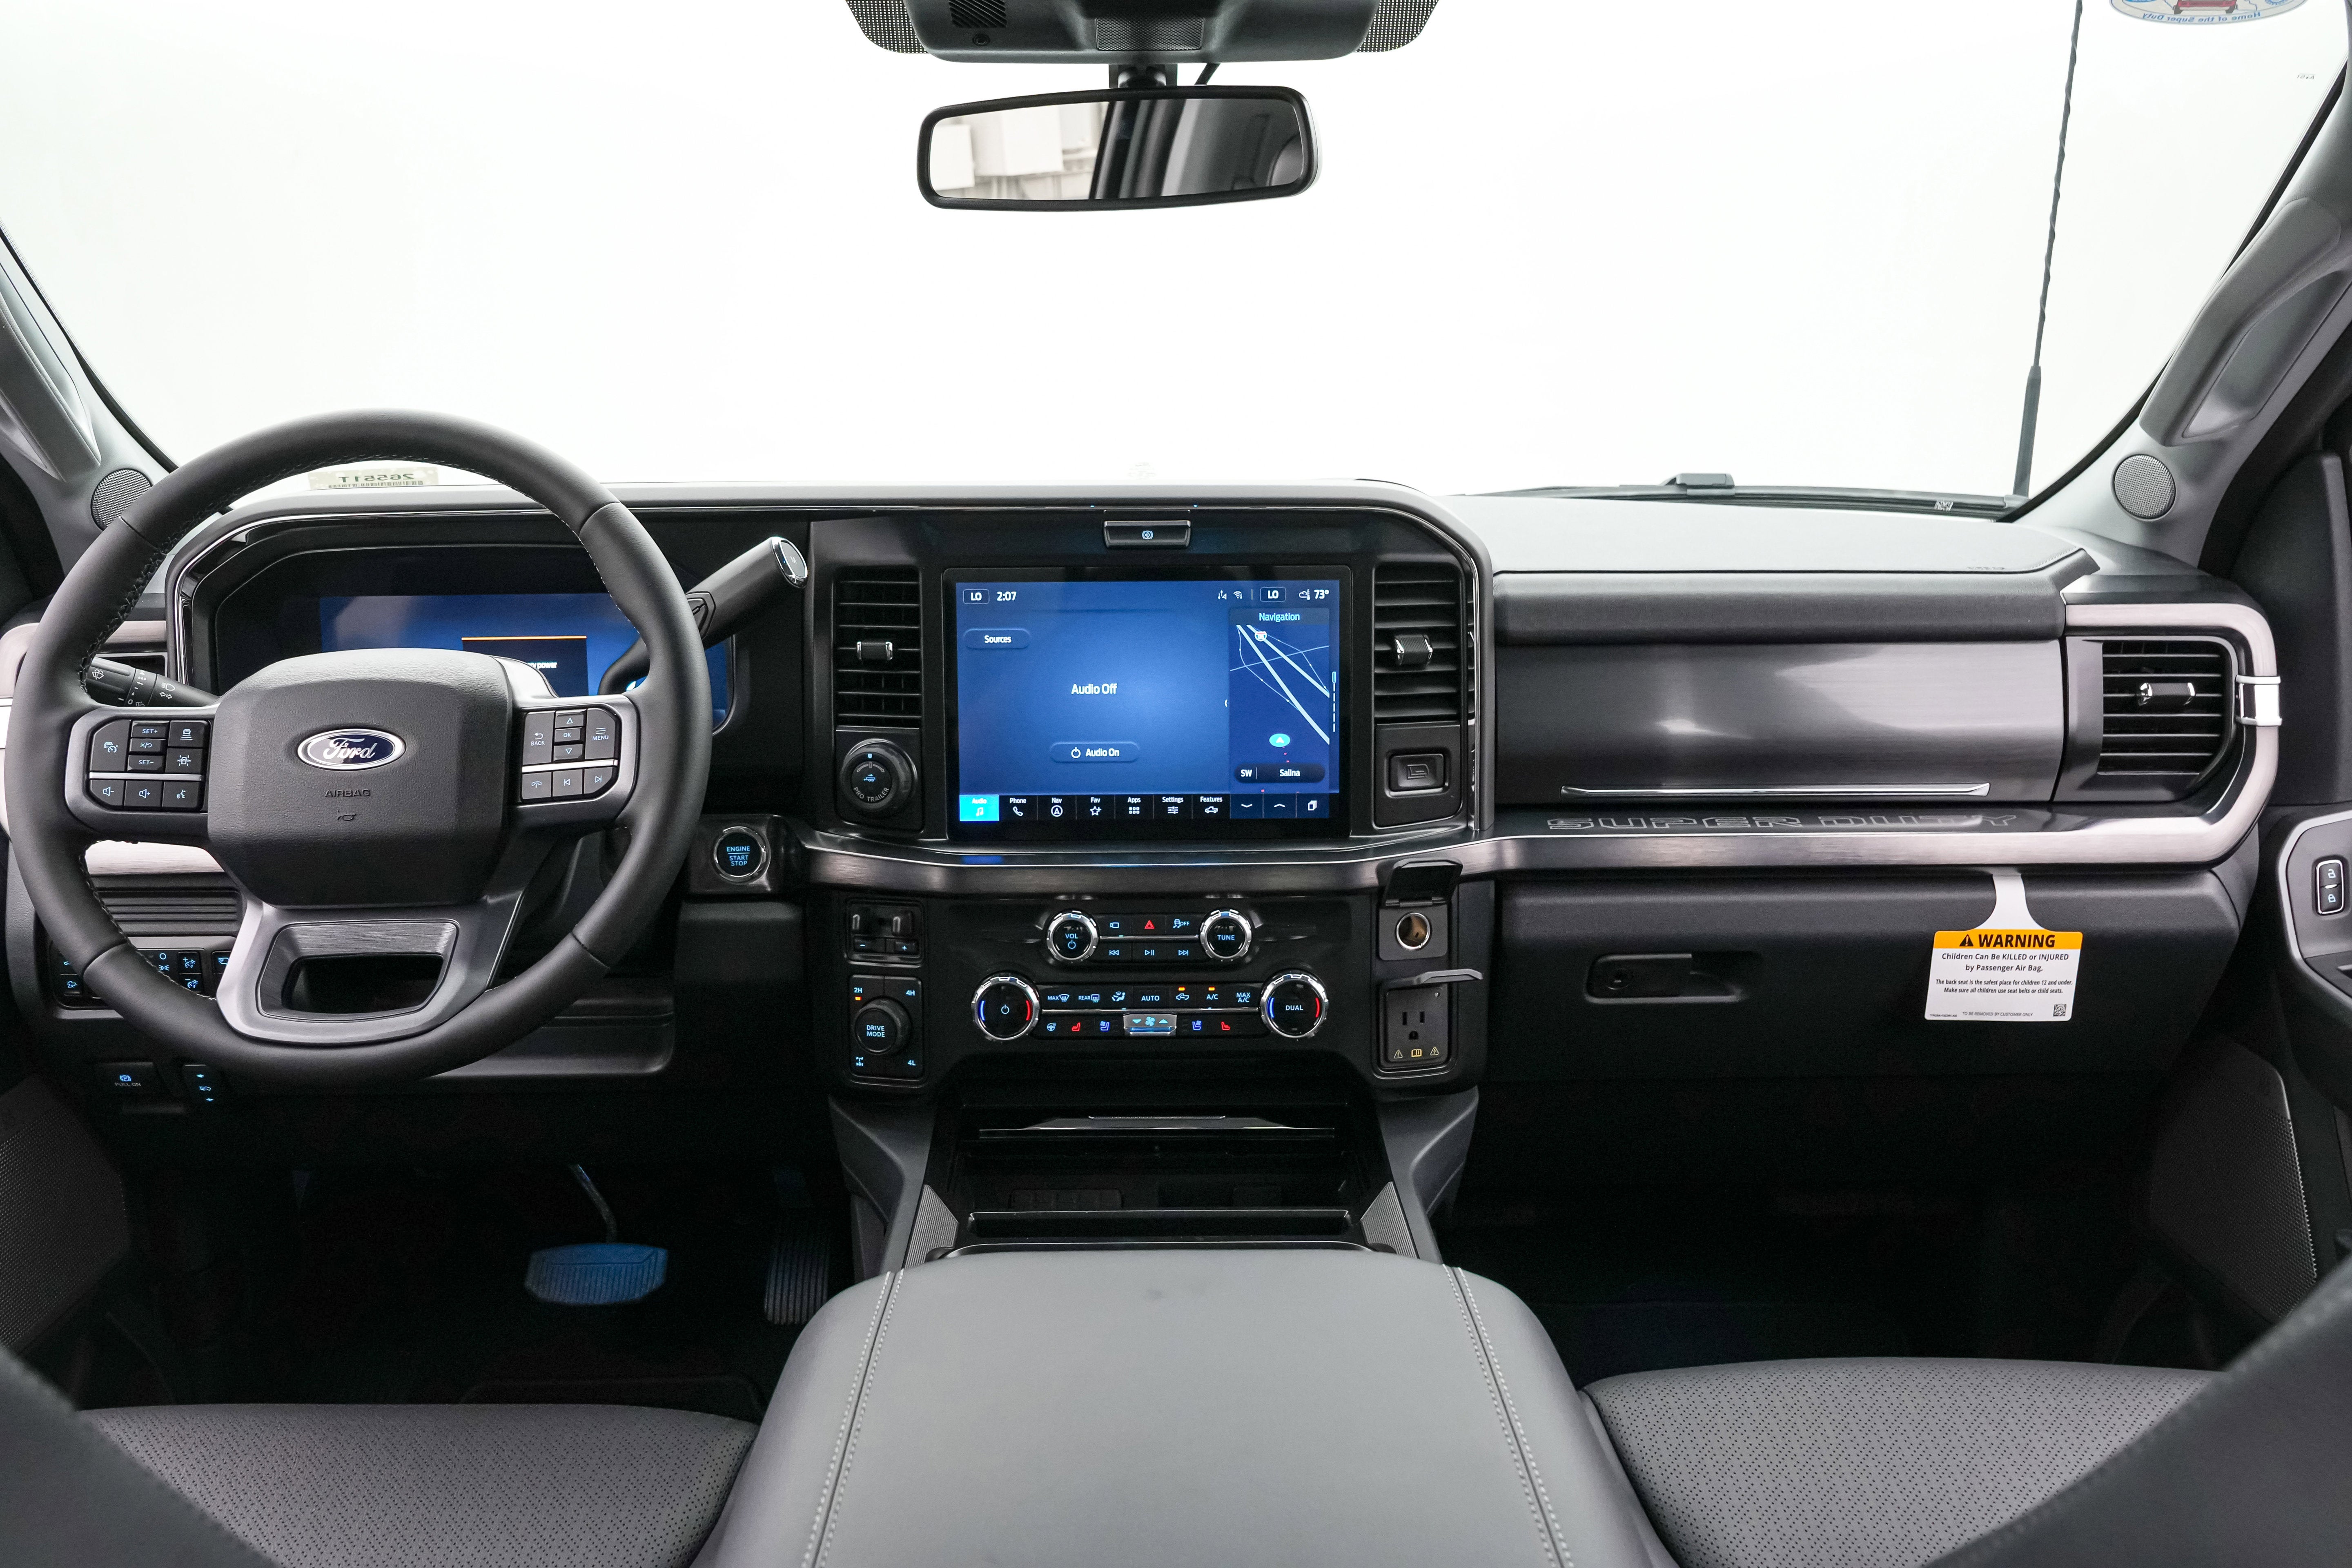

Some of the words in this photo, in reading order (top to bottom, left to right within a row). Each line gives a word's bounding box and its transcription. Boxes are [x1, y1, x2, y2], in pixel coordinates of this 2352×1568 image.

[970, 592, 982, 601] LO
[996, 591, 1017, 601] 2:07
[1267, 590, 1278, 599] LO
[1259, 612, 1300, 623] Navigation
[984, 635, 1012, 643] Sources
[1071, 683, 1100, 695] Audio
[1101, 683, 1117, 694] Off
[323, 737, 378, 760] Ford
[1085, 748, 1107, 757] Audio
[1108, 748, 1120, 757] On
[853, 787, 864, 799] PRO
[866, 787, 889, 802] TRAILER
[1547, 817, 1803, 829] SUPER
[1978, 934, 2056, 947] WARNING
